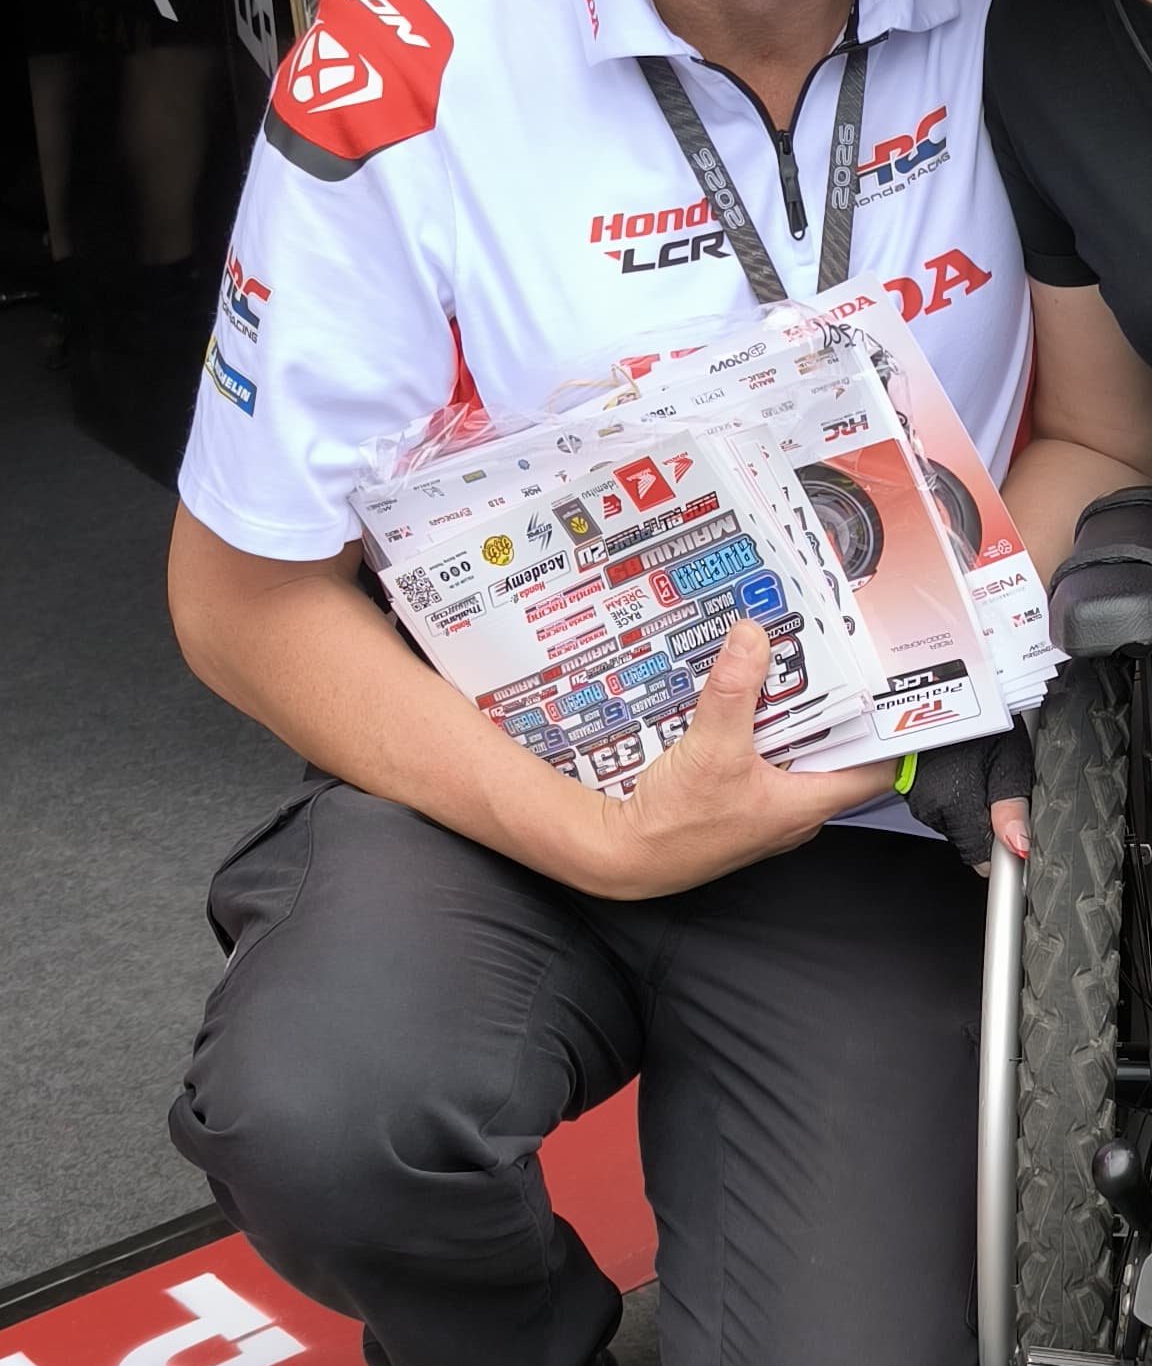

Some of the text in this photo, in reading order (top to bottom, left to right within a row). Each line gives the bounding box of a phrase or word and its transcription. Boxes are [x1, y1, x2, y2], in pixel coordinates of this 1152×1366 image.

[832, 124, 855, 211] 2026
[691, 147, 745, 230] 2026
[621, 231, 731, 274] LCR
[823, 415, 869, 442] HRC
[582, 480, 617, 500] idemitsu
[505, 554, 565, 593] Academy
[971, 573, 1028, 601] SENA
[519, 581, 546, 600] Honda
[568, 579, 606, 605] Honda
[703, 591, 735, 615] BUASRI
[743, 574, 782, 618] 5
[527, 597, 567, 624] Racing
[615, 611, 642, 629] RACE
[892, 672, 933, 692] LCR
